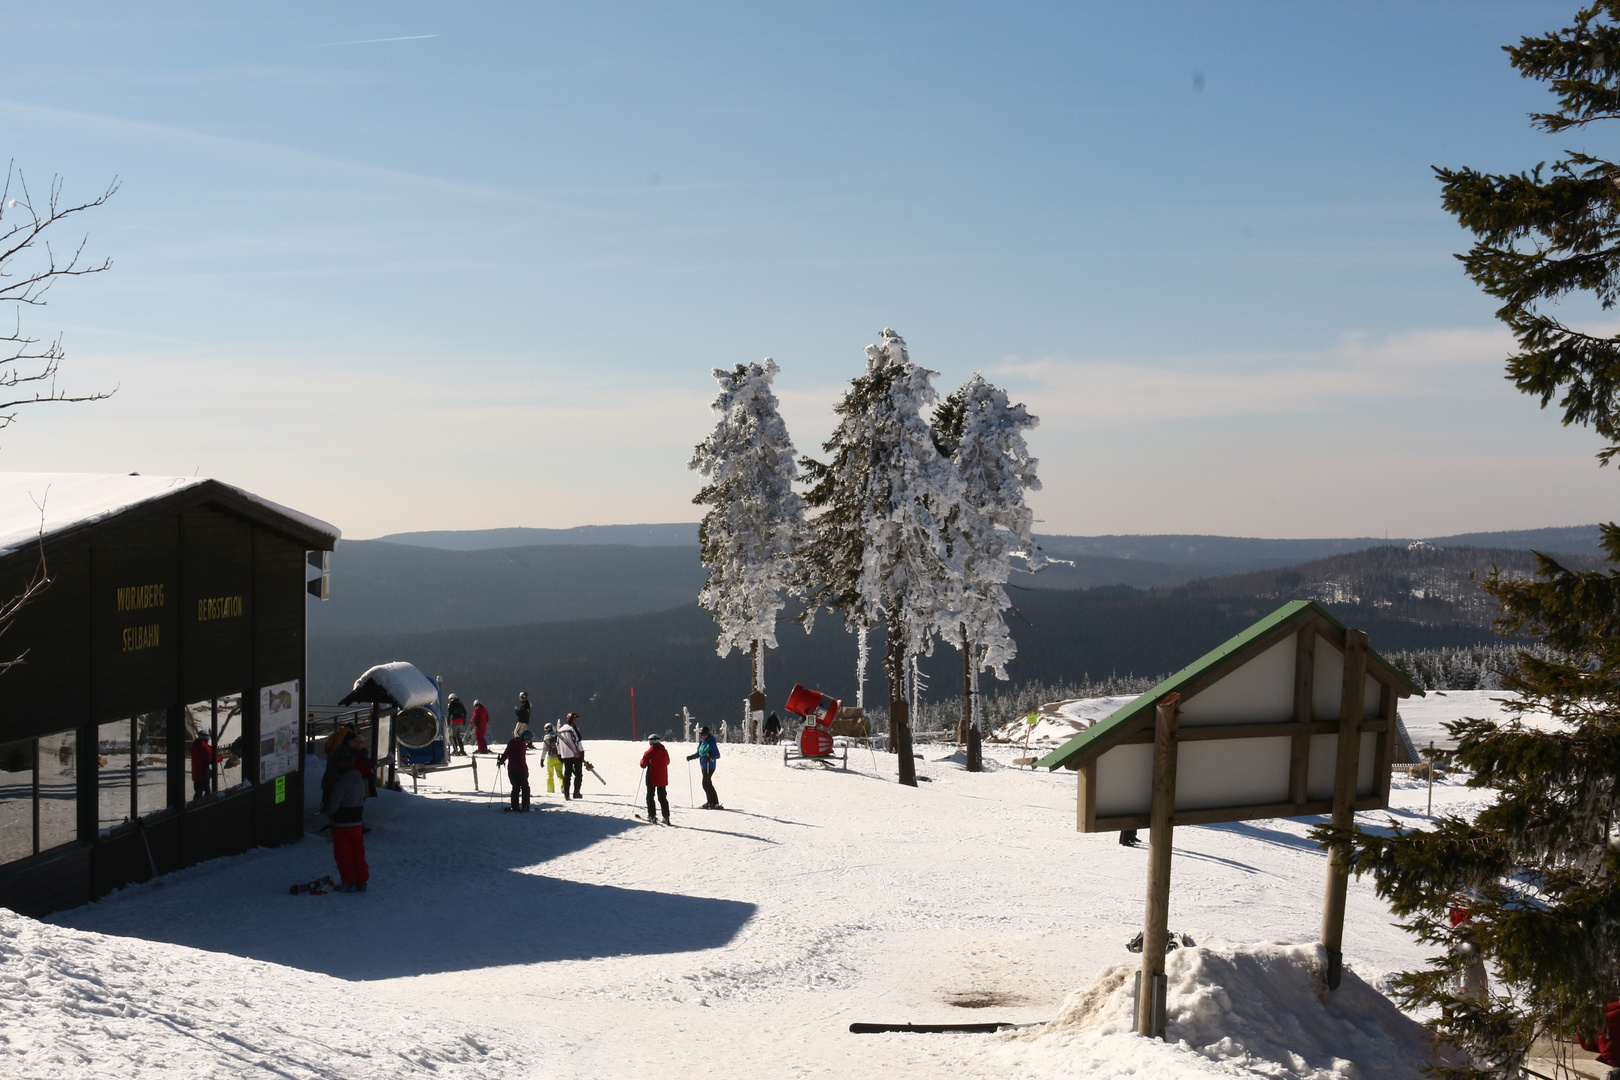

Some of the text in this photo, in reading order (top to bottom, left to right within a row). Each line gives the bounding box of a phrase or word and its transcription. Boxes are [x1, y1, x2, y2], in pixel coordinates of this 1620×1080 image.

[117, 584, 164, 611] WURMBERG
[198, 596, 242, 621] BERGSTATION
[122, 624, 160, 652] SEILBAHN
